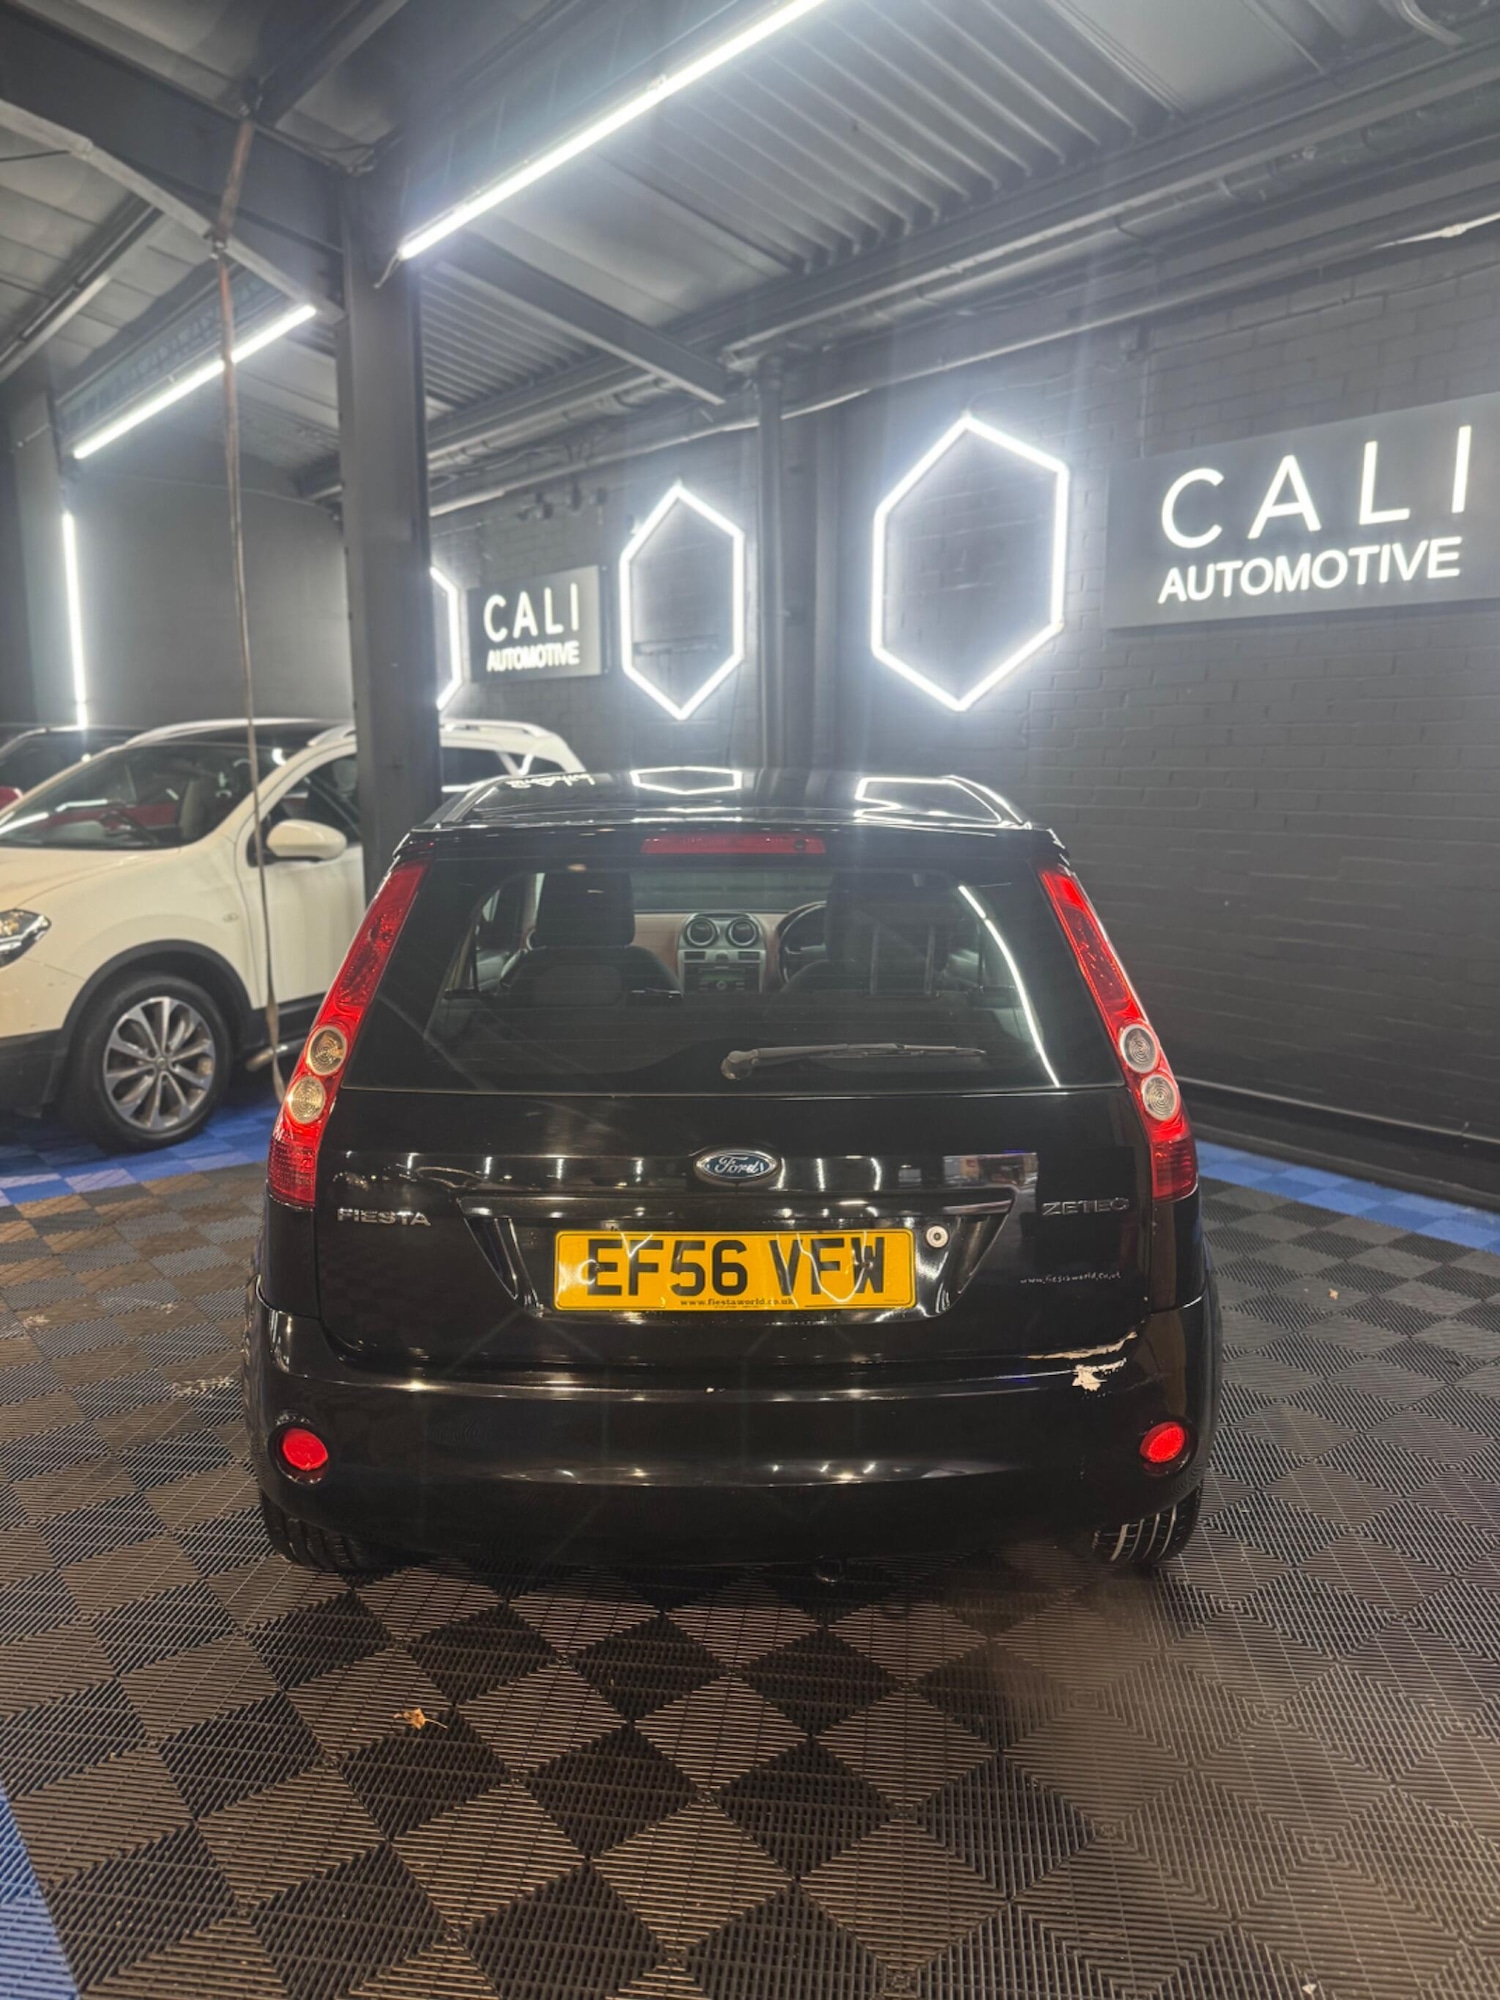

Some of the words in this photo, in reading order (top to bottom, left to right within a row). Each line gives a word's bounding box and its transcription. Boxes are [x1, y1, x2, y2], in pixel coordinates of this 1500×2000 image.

[1161, 425, 1472, 549] CALI
[1157, 536, 1463, 604] AUTOMOTIVE
[483, 582, 580, 643] CALI
[486, 640, 580, 672] AUTOMOTIVE
[714, 1155, 761, 1174] Ford
[337, 1207, 432, 1227] FIESTA
[1042, 1197, 1129, 1215] ZETEC
[587, 1238, 748, 1297] EF56
[768, 1235, 885, 1296] VFW
[679, 1297, 796, 1306] www.fiestaworld.co.uk
